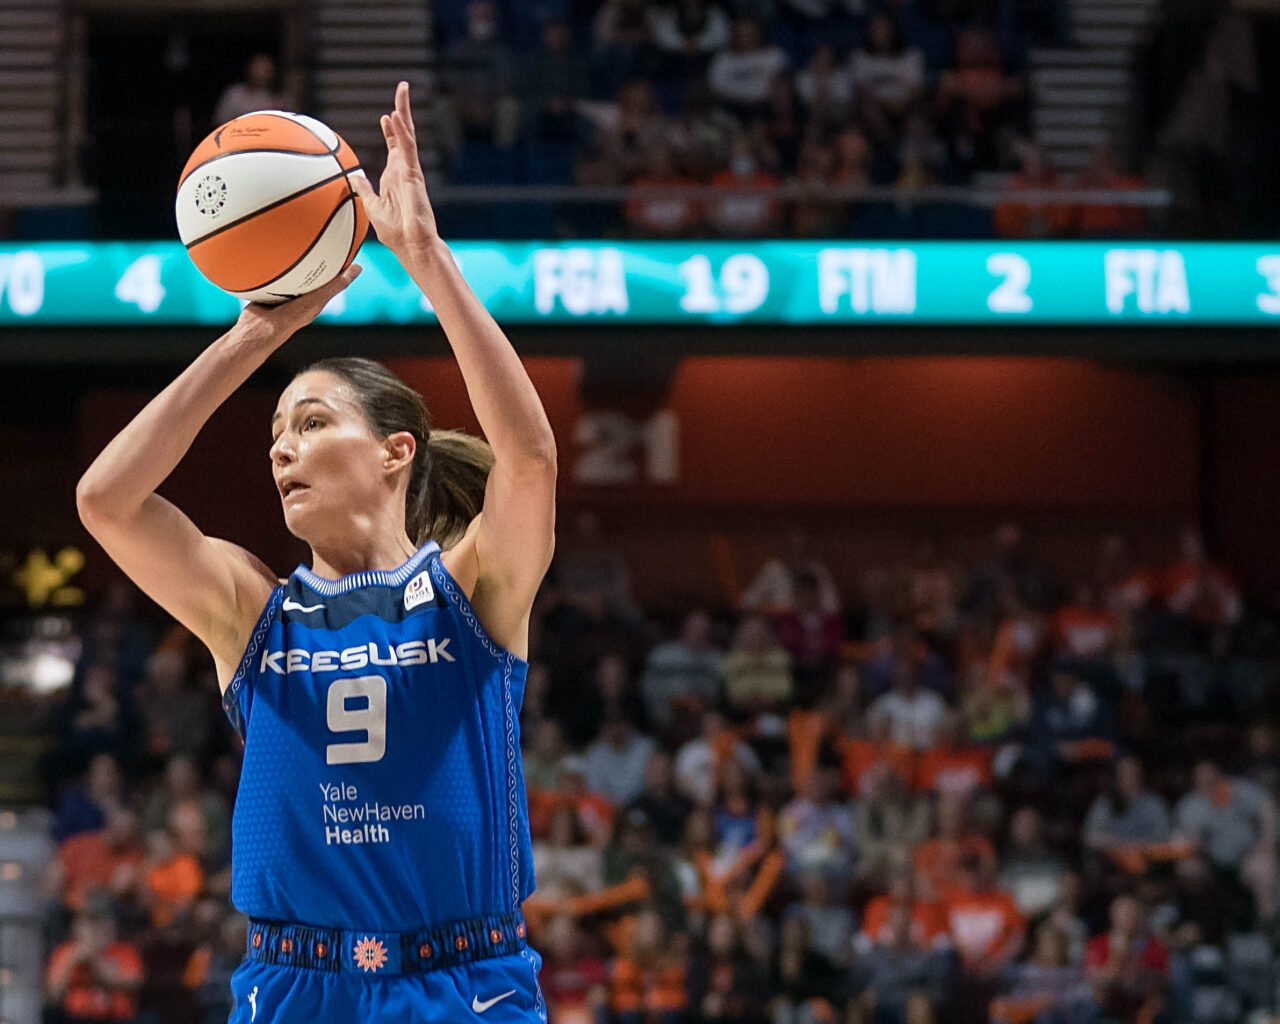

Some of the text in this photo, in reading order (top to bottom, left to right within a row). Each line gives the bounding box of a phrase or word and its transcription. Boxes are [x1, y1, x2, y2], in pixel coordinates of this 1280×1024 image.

[116, 253, 166, 313] 4
[533, 246, 629, 316] FGA
[680, 253, 770, 314] 19
[818, 248, 918, 315] FTM
[985, 253, 1033, 314] 2
[1104, 247, 1190, 315] FTA
[572, 409, 680, 484] 21
[260, 637, 456, 675] KEESUSK
[326, 675, 387, 765] 9
[319, 781, 358, 802] Yale
[322, 801, 425, 824] NewHaven
[325, 824, 390, 845] Health
